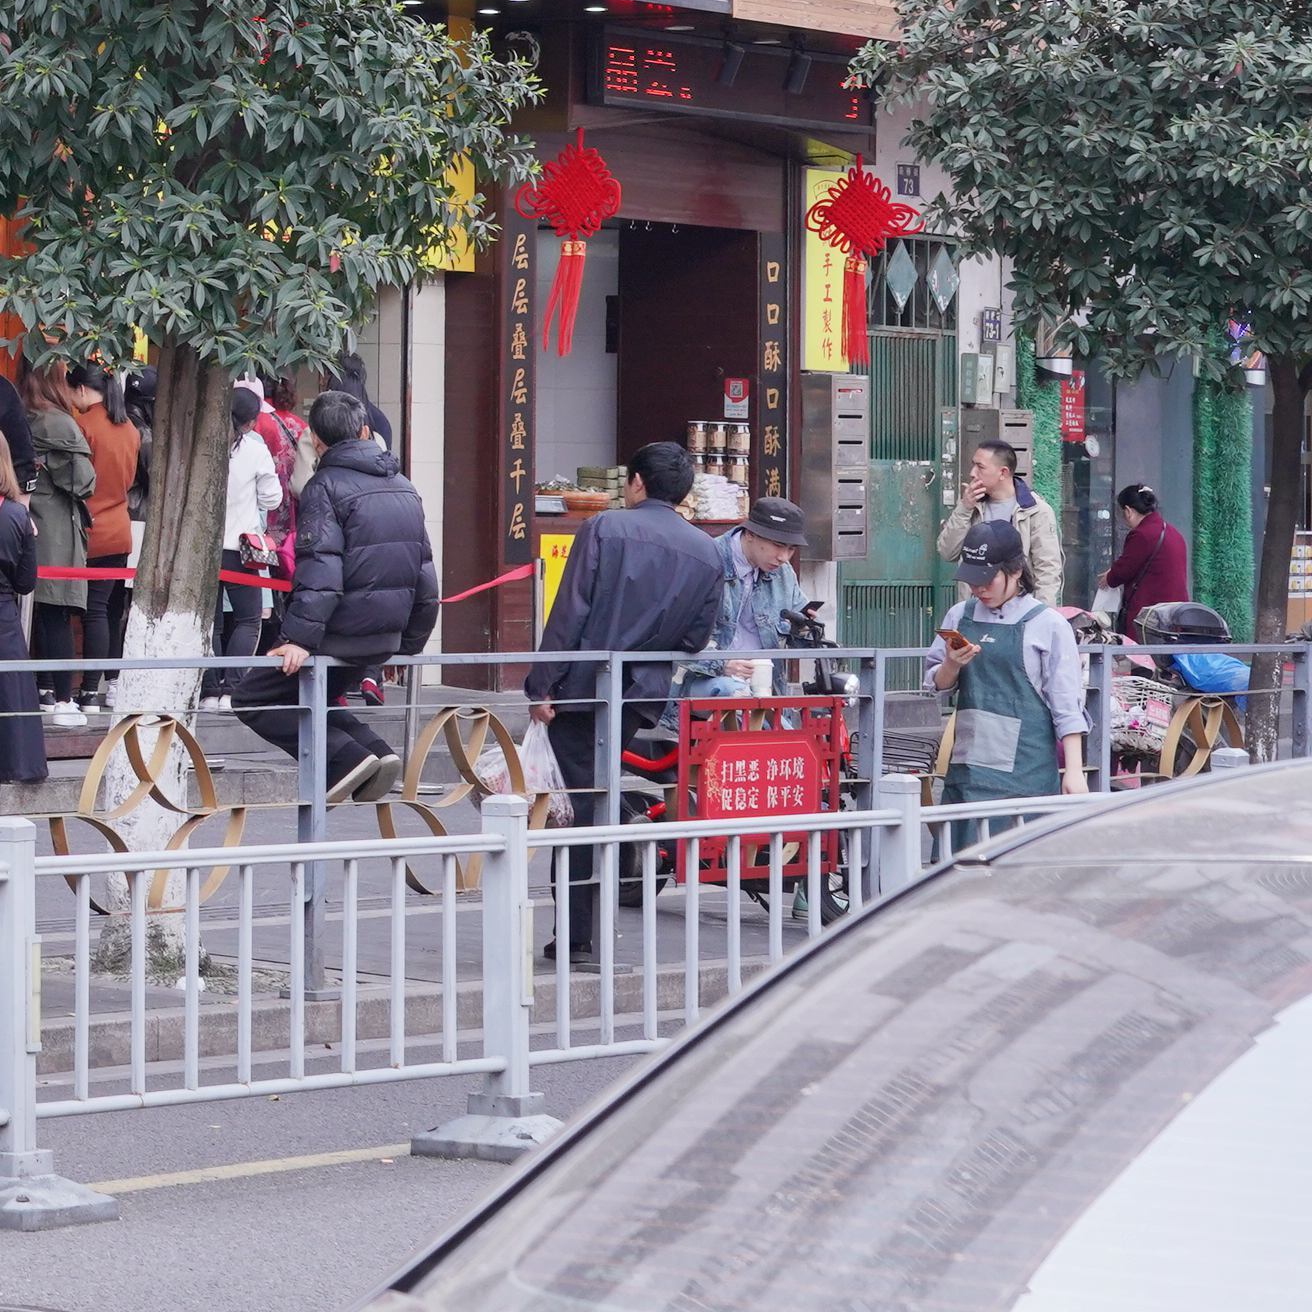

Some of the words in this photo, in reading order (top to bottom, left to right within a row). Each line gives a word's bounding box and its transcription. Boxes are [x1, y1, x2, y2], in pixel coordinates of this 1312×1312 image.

[903, 178, 914, 194] 73
[822, 248, 834, 361] 手工製作
[985, 321, 1000, 340] 73-1
[508, 233, 530, 540] 层层叠层叠千层
[720, 758, 760, 784] 扫黑恶
[766, 756, 805, 782] 净环境
[721, 786, 760, 811] 促稳定
[766, 784, 805, 809] 保平安
